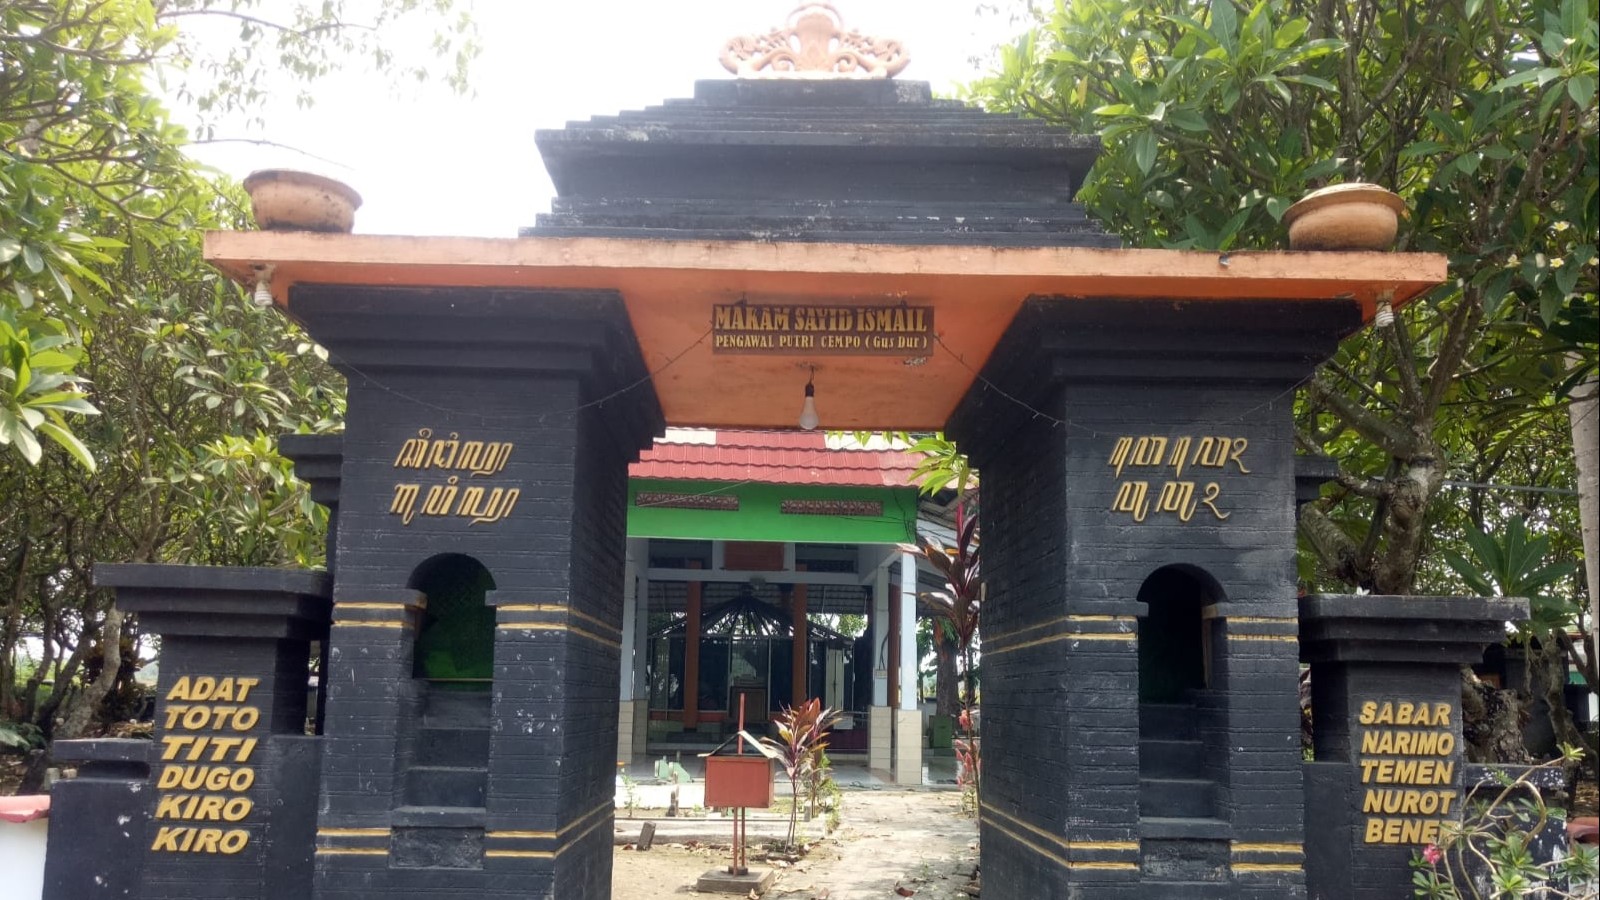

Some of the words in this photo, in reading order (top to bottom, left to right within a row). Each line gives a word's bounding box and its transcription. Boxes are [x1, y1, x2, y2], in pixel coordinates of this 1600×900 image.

[715, 306, 790, 331] MAKAM
[794, 307, 852, 332] SAYID
[857, 308, 927, 332] ISMAIL
[716, 335, 774, 348] PENGAWAL
[780, 335, 814, 348] PUTRI
[821, 335, 861, 349] CEMPO
[166, 676, 258, 702] ADAT
[165, 705, 259, 730] TOTO
[1359, 701, 1451, 725] SABAR
[161, 736, 257, 762] TITI
[1361, 731, 1454, 755] NARIMO
[157, 766, 254, 791] DUGO
[1360, 760, 1454, 784] TEMEN
[156, 795, 253, 821] KIRO
[1363, 789, 1456, 814] NUROT
[151, 827, 249, 853] KIRO
